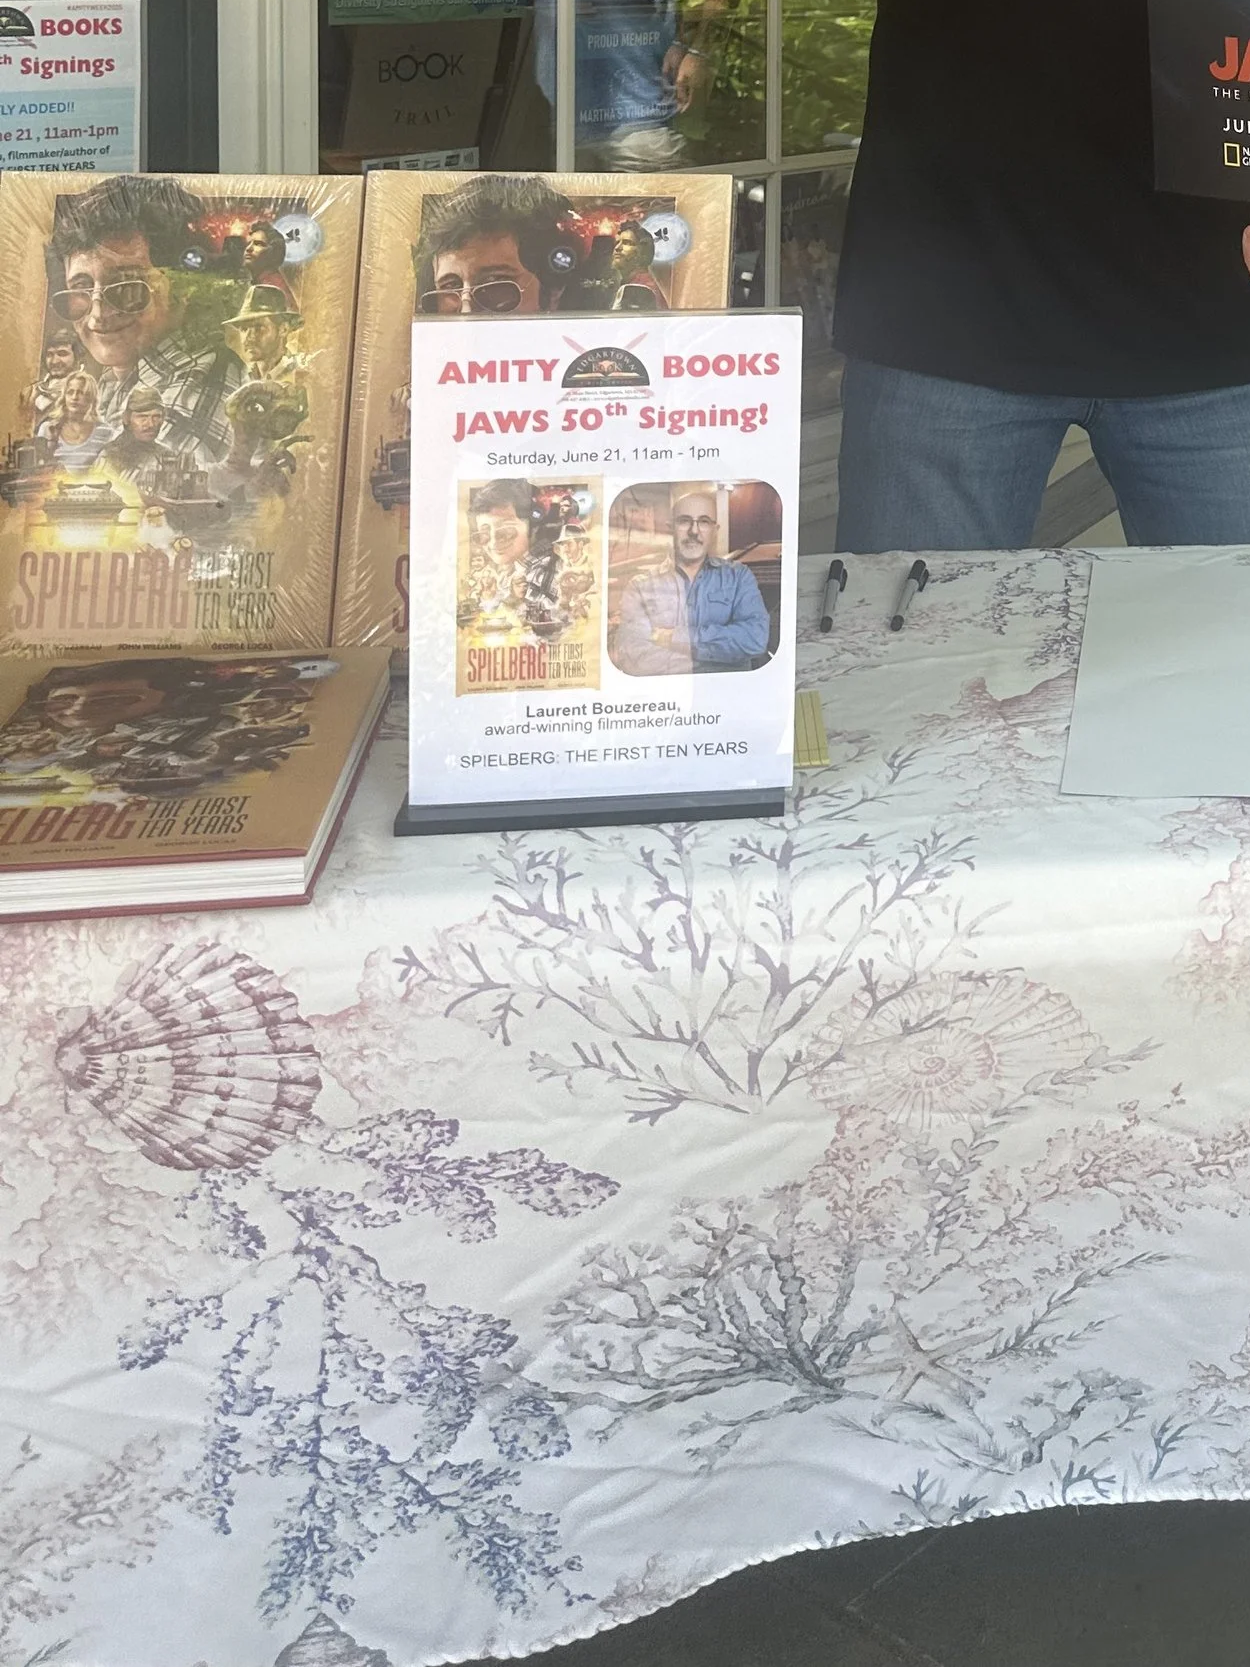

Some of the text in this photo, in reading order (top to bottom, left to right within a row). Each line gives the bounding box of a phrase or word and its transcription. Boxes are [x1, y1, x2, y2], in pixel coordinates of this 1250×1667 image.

[41, 18, 122, 36] BOOKS
[587, 31, 661, 50] PROUD MEMBER
[20, 56, 115, 79] Signings
[378, 53, 465, 83] BOOK
[1213, 86, 1241, 101] THE
[19, 102, 75, 115] ADDED!!
[393, 105, 456, 126] TRAIL
[16, 128, 33, 141] 21
[44, 125, 119, 140] 11am-1pm
[8, 147, 98, 161] filmmaker/author
[99, 145, 111, 155] of
[40, 163, 60, 172] TEN
[62, 161, 96, 171] YEARS
[437, 353, 780, 384] AMITY BOOKS
[452, 402, 769, 442] JAWS 50th Signing!
[487, 449, 559, 467] Saturday,
[562, 449, 599, 464] June
[604, 448, 627, 463] 21,
[632, 447, 673, 461] 11am
[689, 445, 720, 461] 1pm
[196, 550, 275, 590] THE FIRST
[14, 550, 193, 631] SPIELBERG
[194, 591, 278, 630] TEN YEARS
[117, 643, 141, 651] JOHN
[142, 643, 182, 652] WILLIAMS
[211, 642, 246, 651] GEORGE
[247, 642, 274, 651] LUCAS
[549, 643, 584, 661] THE FIRST
[467, 643, 547, 683] SPIELBERG
[548, 660, 587, 680] TEN YEARS
[526, 700, 681, 718] Laurent Bouzereau,
[484, 712, 721, 737] award-winning filmmaker/author
[460, 741, 748, 769] SPIELBERG: THE FIRST TEN YEARS
[149, 795, 251, 819] THE FIRST
[136, 814, 249, 839] TEN YEARS
